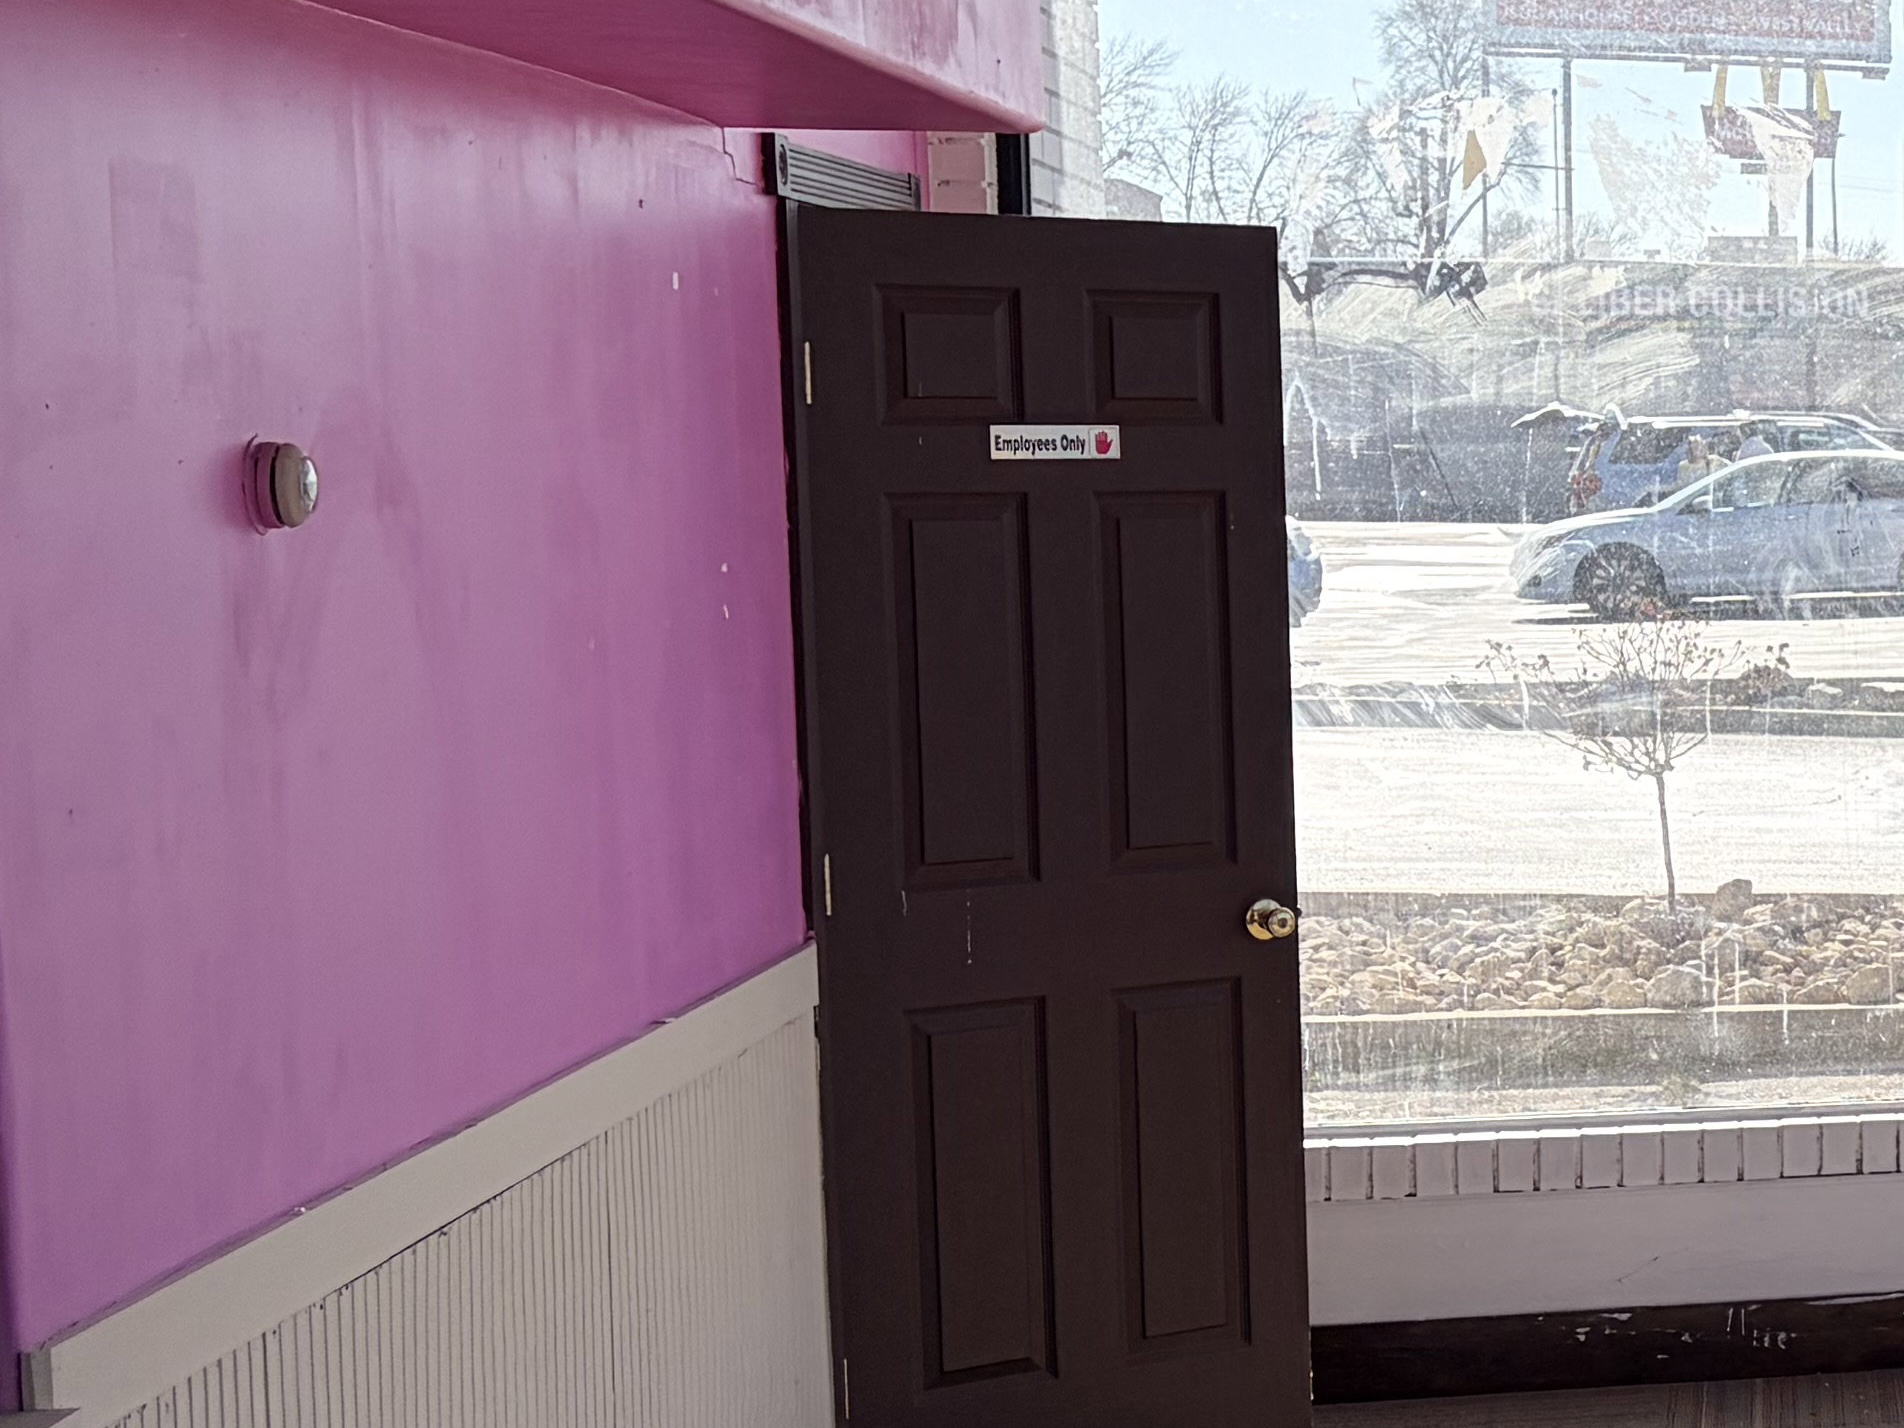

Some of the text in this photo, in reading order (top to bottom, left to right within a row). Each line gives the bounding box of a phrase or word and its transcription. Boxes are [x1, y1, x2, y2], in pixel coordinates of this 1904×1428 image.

[1689, 285, 1870, 320] COLLISION
[994, 434, 1086, 456] Employees Only
